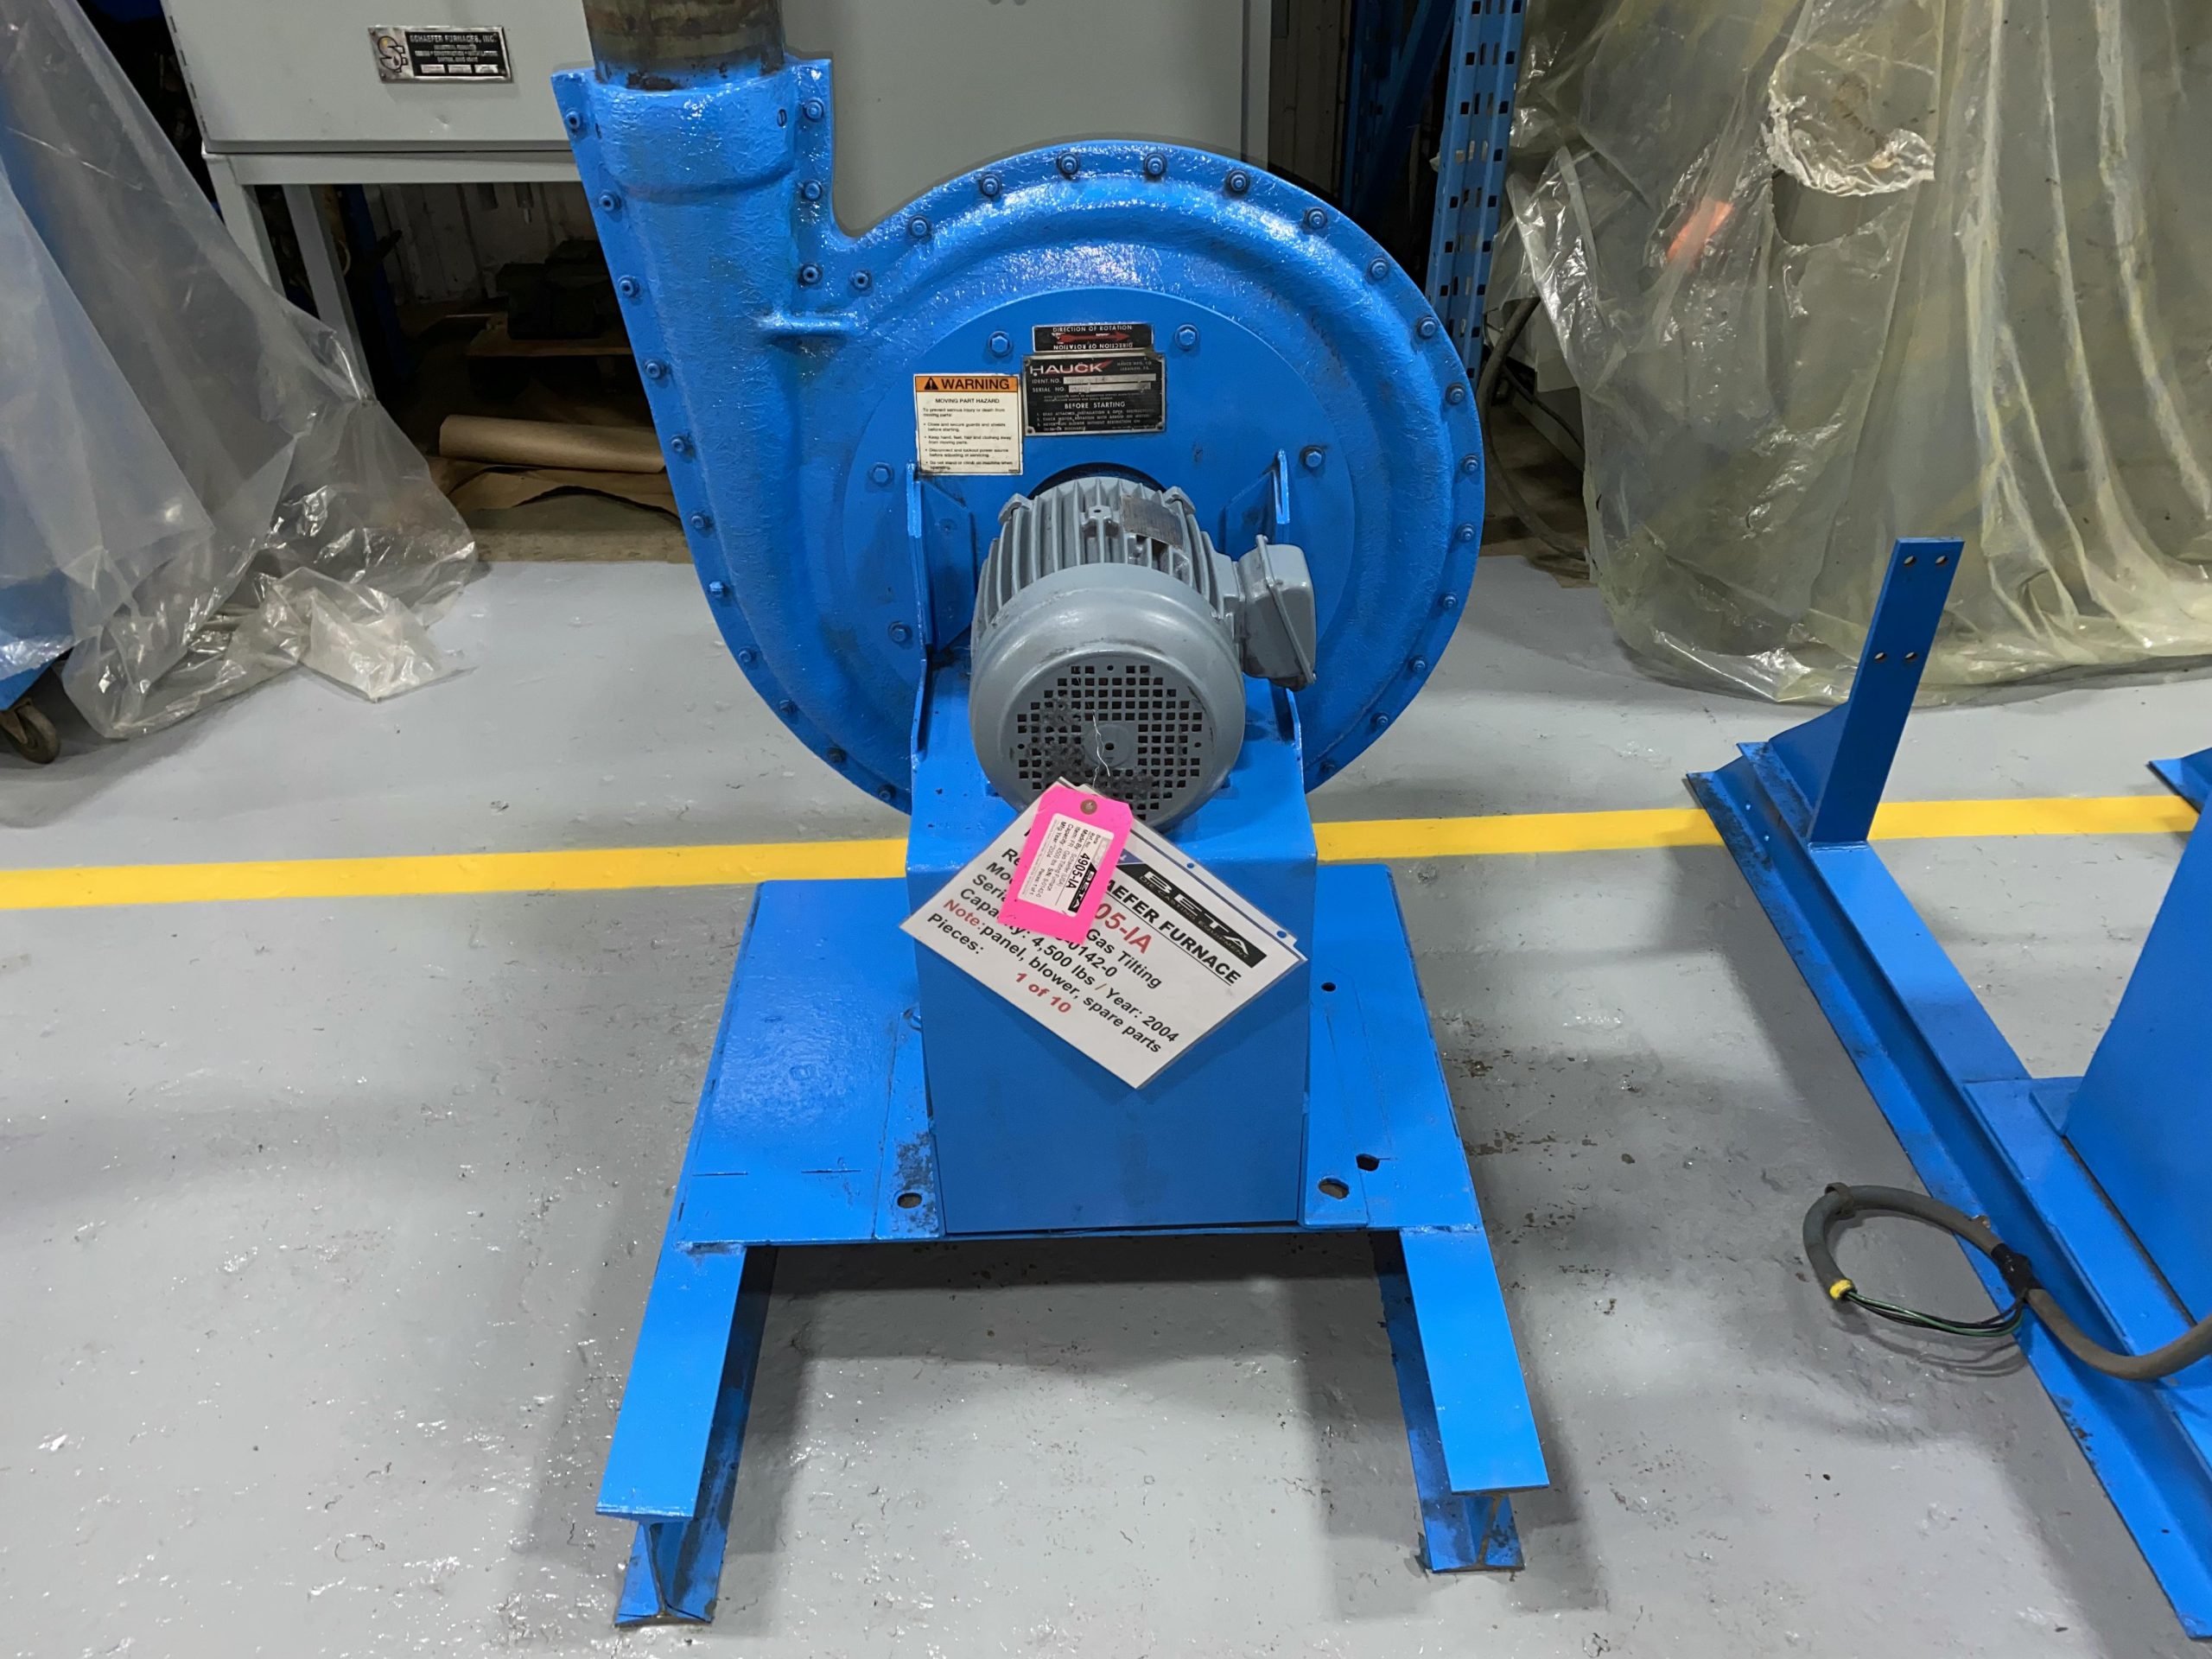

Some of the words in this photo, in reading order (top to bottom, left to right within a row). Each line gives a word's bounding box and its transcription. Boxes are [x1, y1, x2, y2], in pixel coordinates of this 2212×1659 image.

[941, 378, 1010, 390] WARNING
[1030, 363, 1103, 374] HAUCK
[1053, 847, 1062, 858] 4500
[1061, 850, 1070, 859] Gas
[1077, 829, 1088, 842] Made
[1046, 873, 1059, 891] Furnace
[1066, 853, 1090, 889] 4905-IA
[1087, 903, 1151, 954] 05-IA
[1144, 871, 1249, 955] BETA
[1158, 890, 1196, 920] CASTING
[1198, 921, 1249, 958] EQUIPMENT
[927, 913, 983, 954] Pieces:
[1016, 974, 1027, 982] 1
[1028, 984, 1050, 996] of
[1051, 996, 1071, 1013] 10
[1056, 938, 1117, 976] -0142-0
[1086, 929, 1115, 954] Gas
[1118, 950, 1161, 988] Tilting
[1159, 920, 1241, 983] FURNACE
[1028, 957, 1080, 999] blower,
[1084, 998, 1123, 1027] spare
[1122, 1026, 1160, 1052] parts
[1032, 938, 1072, 967] 4,500
[1071, 965, 1095, 985] lbs
[1106, 988, 1142, 1018] Year:
[1142, 1016, 1179, 1041] 2004
